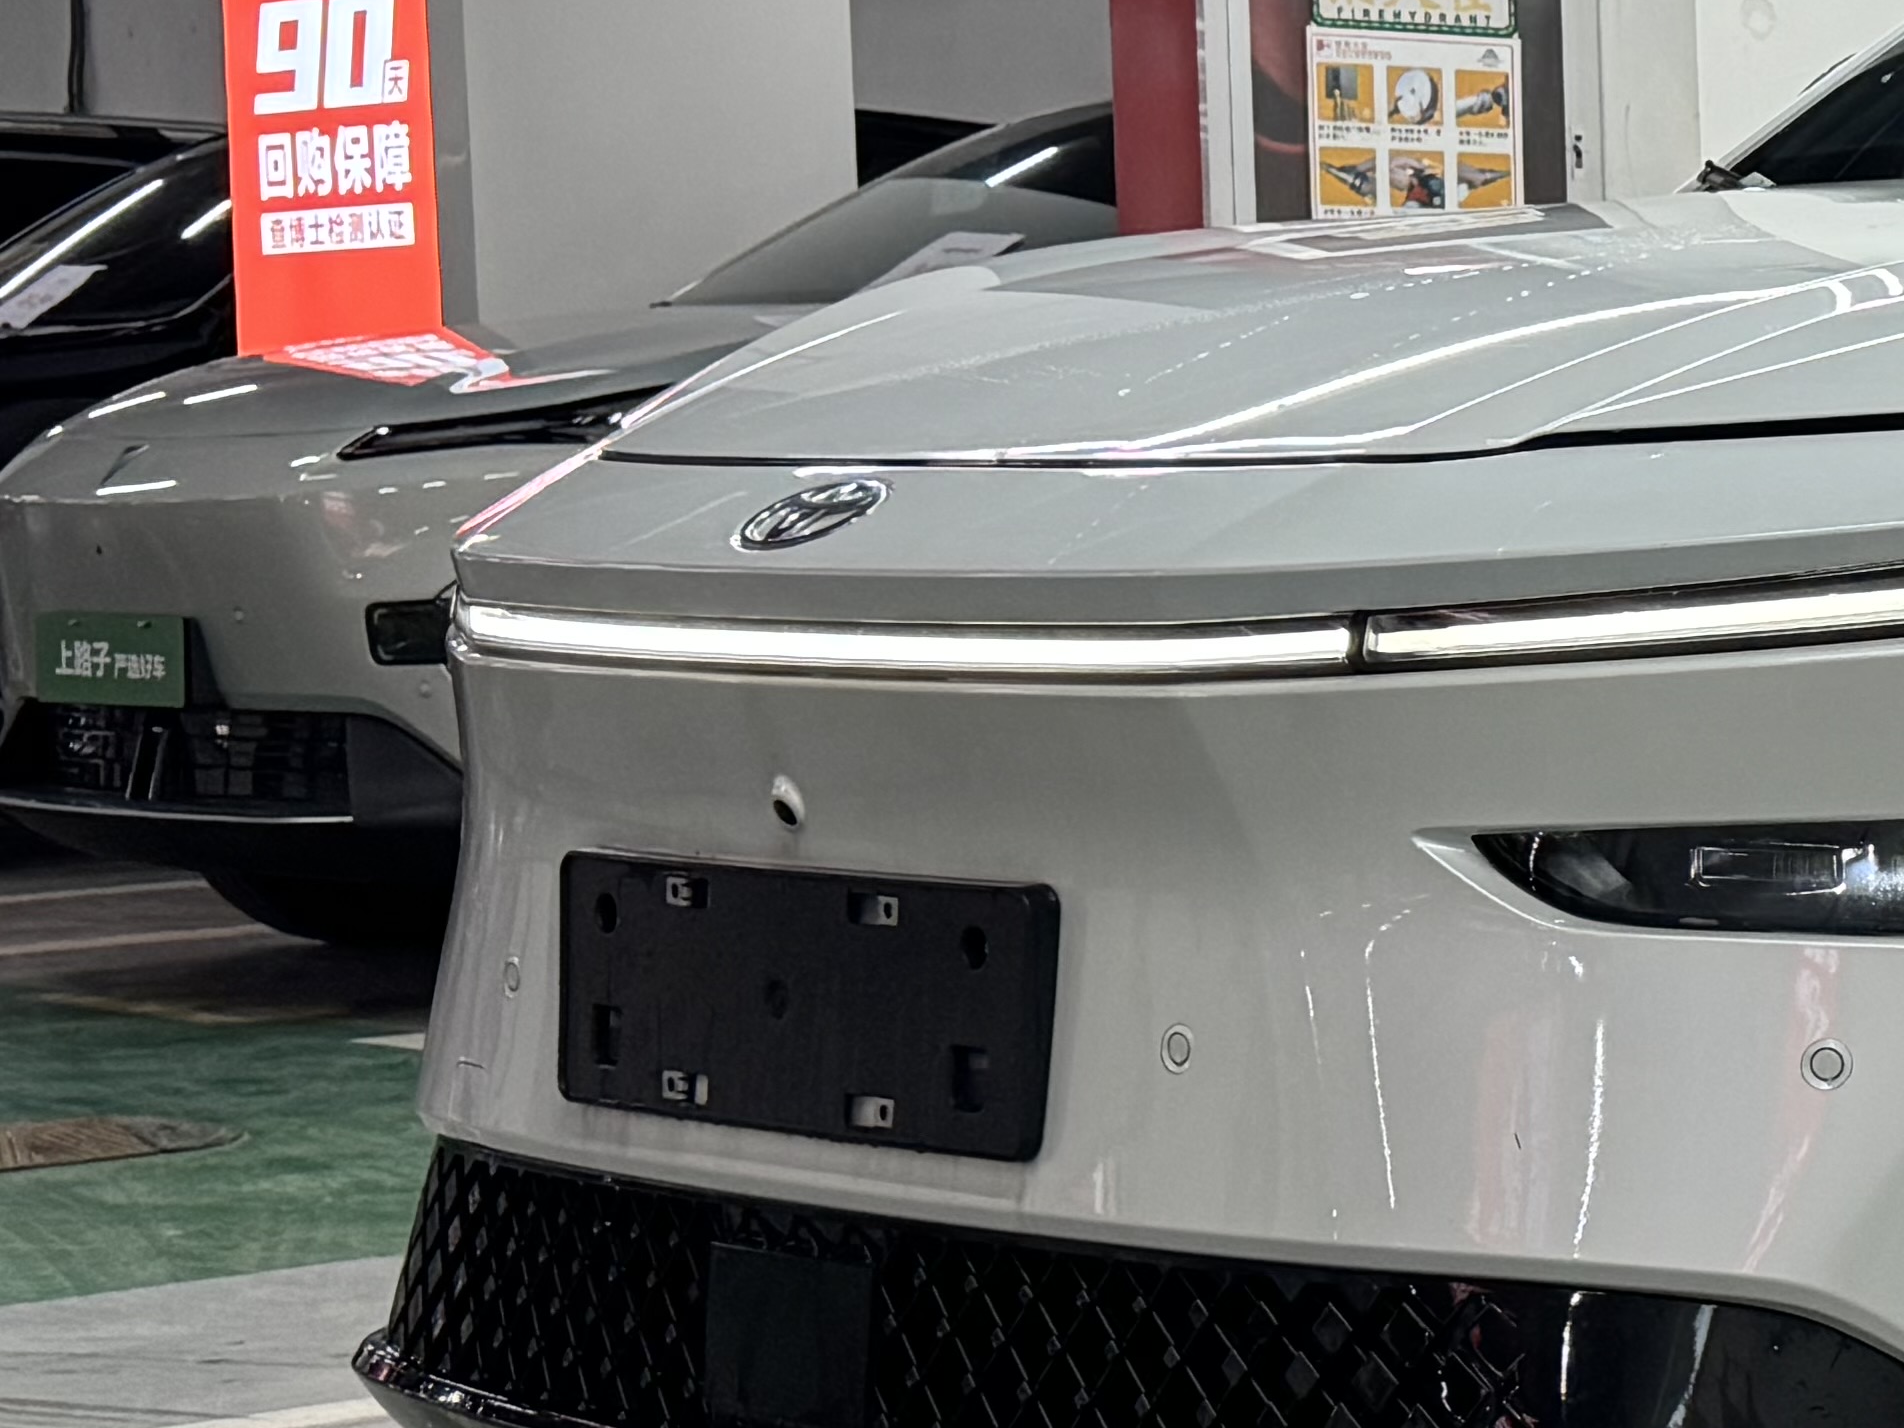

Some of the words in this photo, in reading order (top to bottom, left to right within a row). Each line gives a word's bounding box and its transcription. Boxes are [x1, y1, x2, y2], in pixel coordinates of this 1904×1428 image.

[257, 120, 413, 202] 回购保障
[55, 639, 112, 678] 上路子
